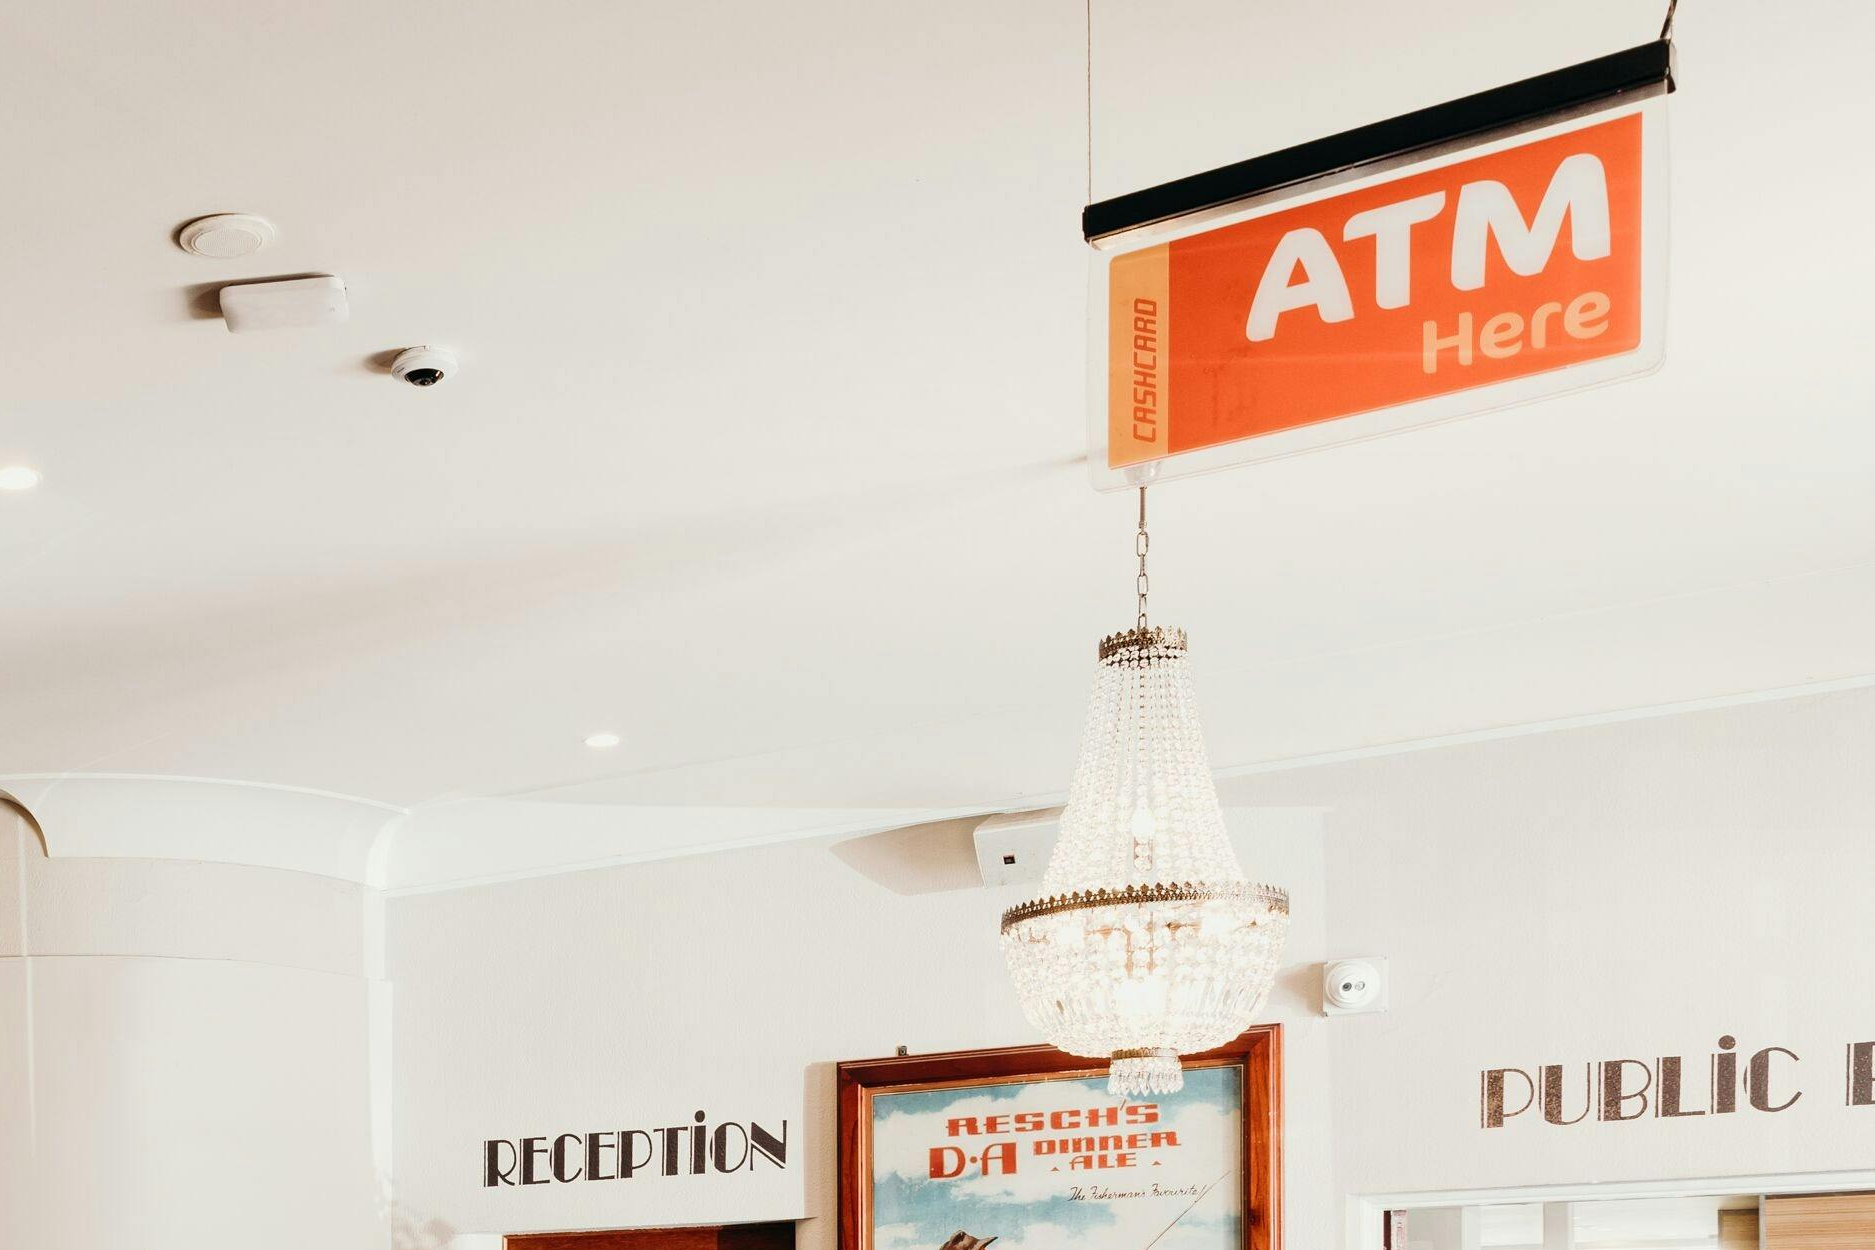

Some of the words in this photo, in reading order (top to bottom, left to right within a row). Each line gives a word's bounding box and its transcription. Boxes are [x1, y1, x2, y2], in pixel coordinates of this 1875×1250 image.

[1246, 153, 1612, 342] ATM
[1423, 291, 1612, 374] Here
[1132, 298, 1157, 444] CASHCARD
[945, 1099, 1159, 1137] RESCH'S
[1069, 1152, 1137, 1171] ALE
[1067, 1186, 1086, 1201] The
